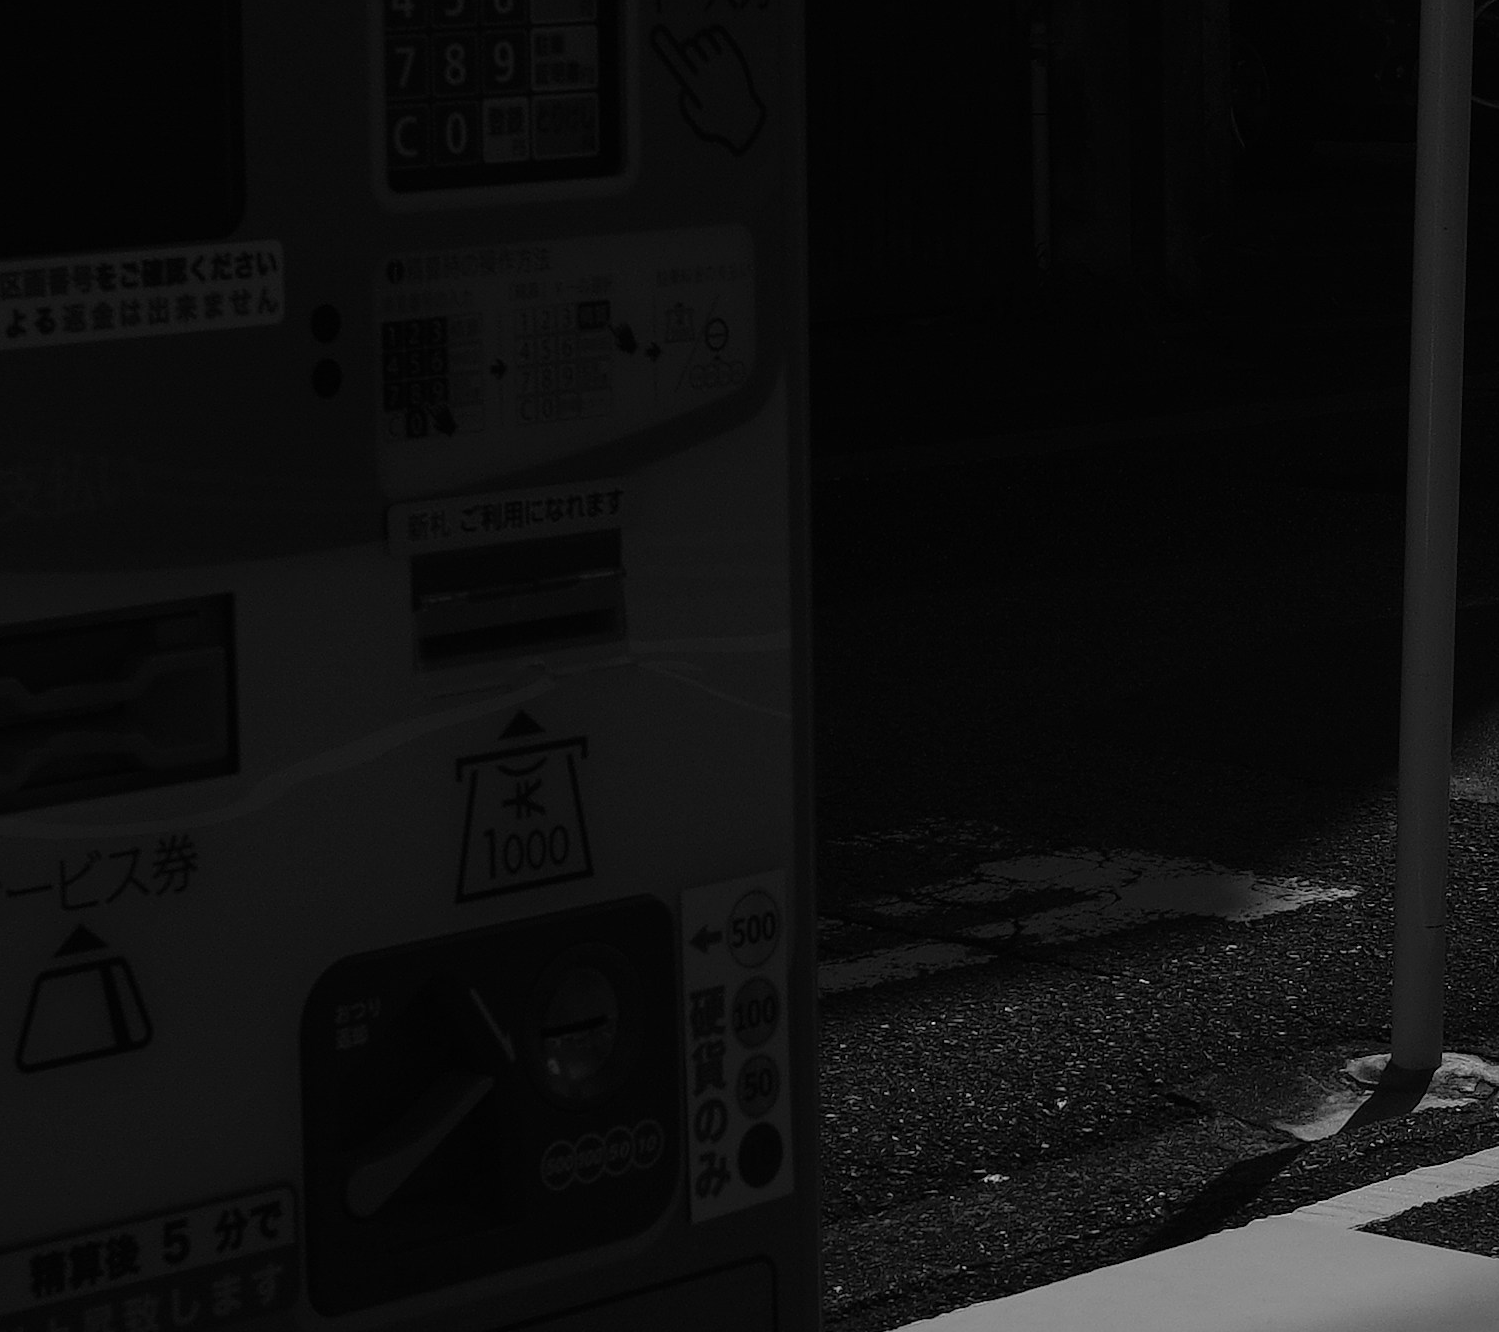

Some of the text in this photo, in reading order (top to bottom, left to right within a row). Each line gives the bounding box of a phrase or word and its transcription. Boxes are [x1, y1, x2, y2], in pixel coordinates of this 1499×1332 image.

[394, 46, 417, 89] 7
[445, 42, 468, 86] 8
[493, 39, 516, 84] 9
[393, 115, 419, 158] C
[446, 111, 468, 155] 0
[483, 825, 571, 880] 1000
[732, 911, 776, 949] 500
[734, 996, 777, 1033] 100
[745, 1068, 772, 1102] 50
[162, 1219, 190, 1266] 5
